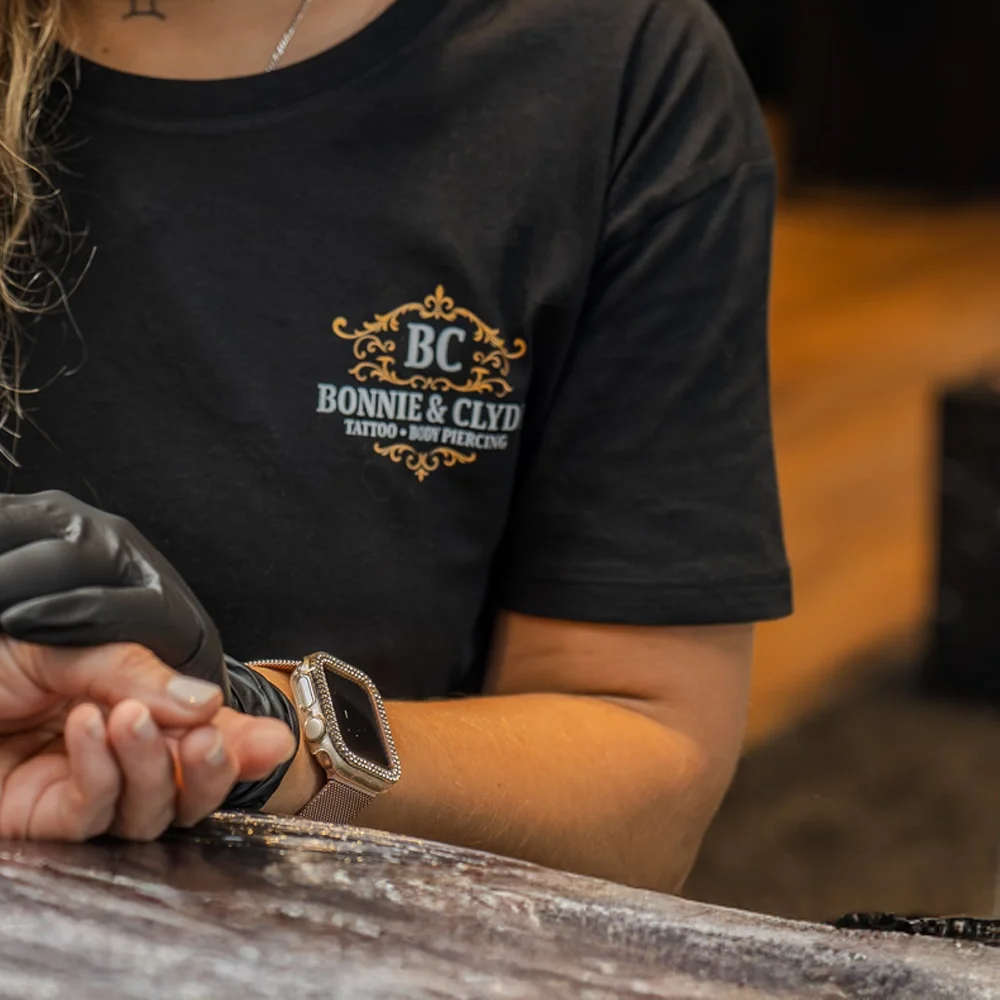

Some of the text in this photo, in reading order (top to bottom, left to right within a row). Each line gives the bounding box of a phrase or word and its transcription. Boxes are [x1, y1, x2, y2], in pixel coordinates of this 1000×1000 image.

[403, 322, 466, 372] BC
[316, 383, 525, 432] BONNIE & CLYD
[344, 419, 398, 439] TATTOO
[441, 428, 508, 450] PIERCING
